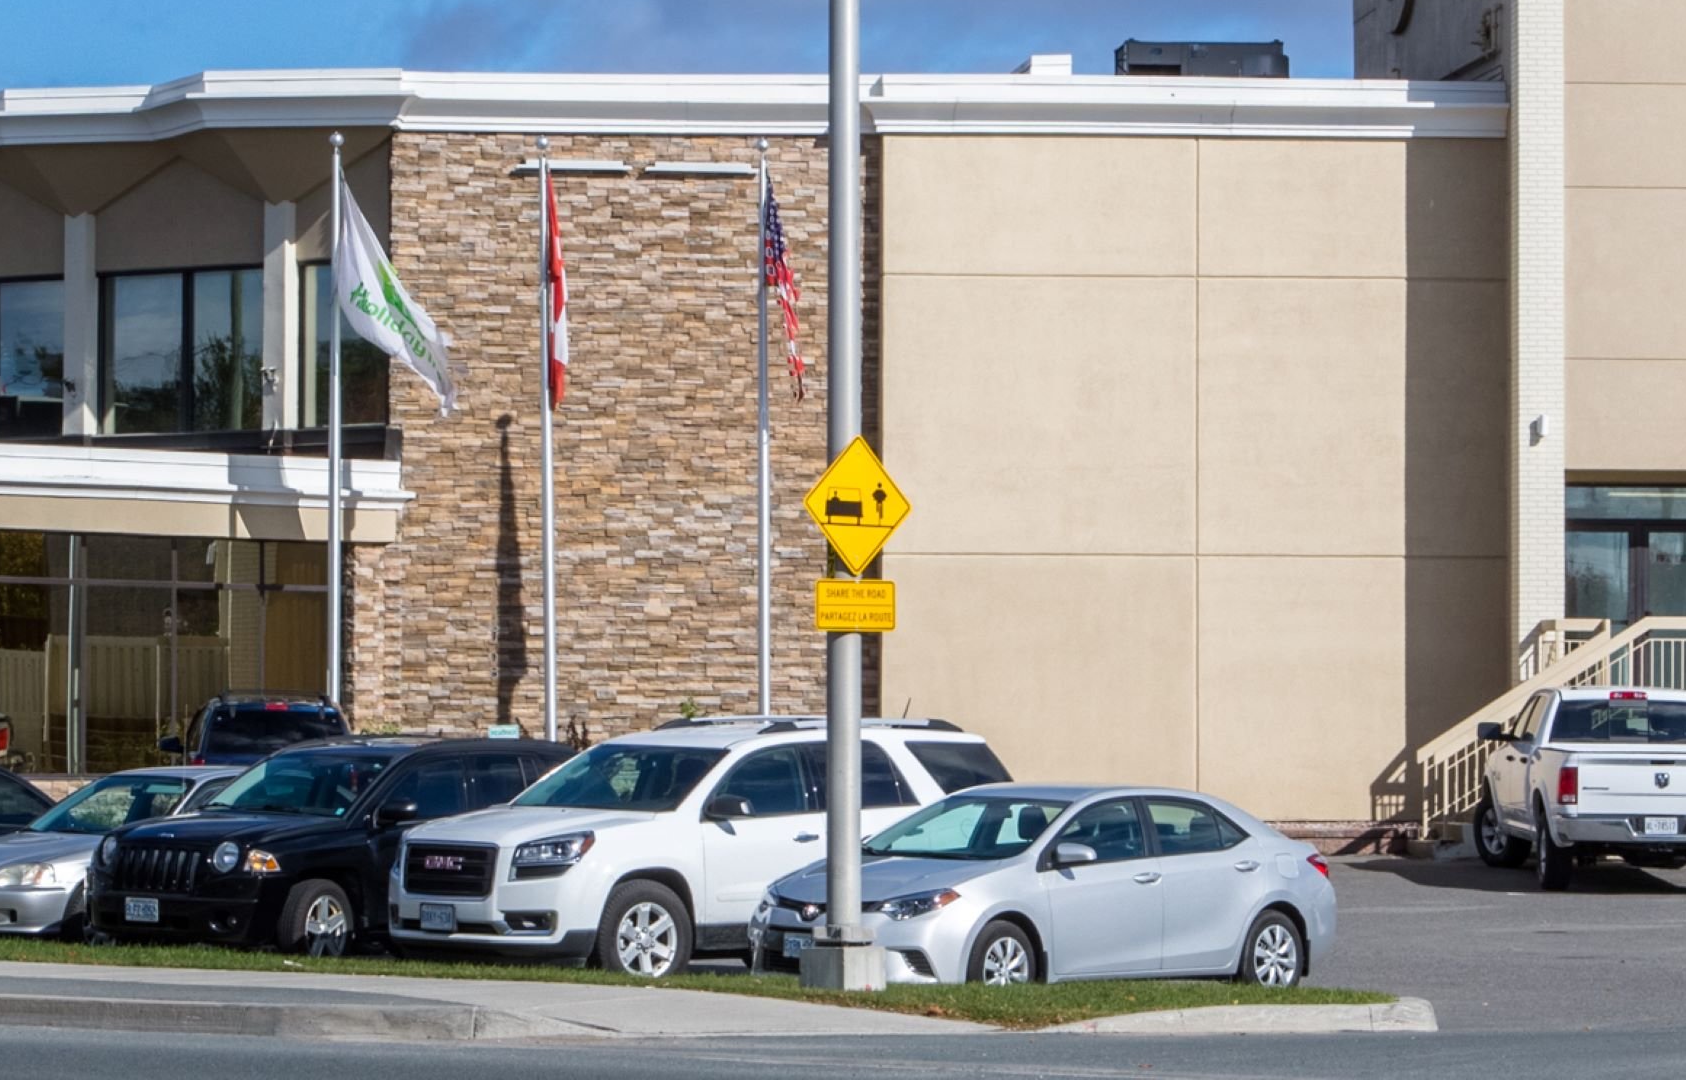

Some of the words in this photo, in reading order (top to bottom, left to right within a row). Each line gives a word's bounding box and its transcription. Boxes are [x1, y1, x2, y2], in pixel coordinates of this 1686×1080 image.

[826, 587, 849, 599] SHARE
[851, 588, 864, 599] THE
[867, 588, 887, 599] ROAD
[820, 611, 856, 622] PARTAGEZ
[858, 612, 867, 622] LA
[869, 612, 892, 623] ROUTE
[425, 855, 464, 870] GMC
